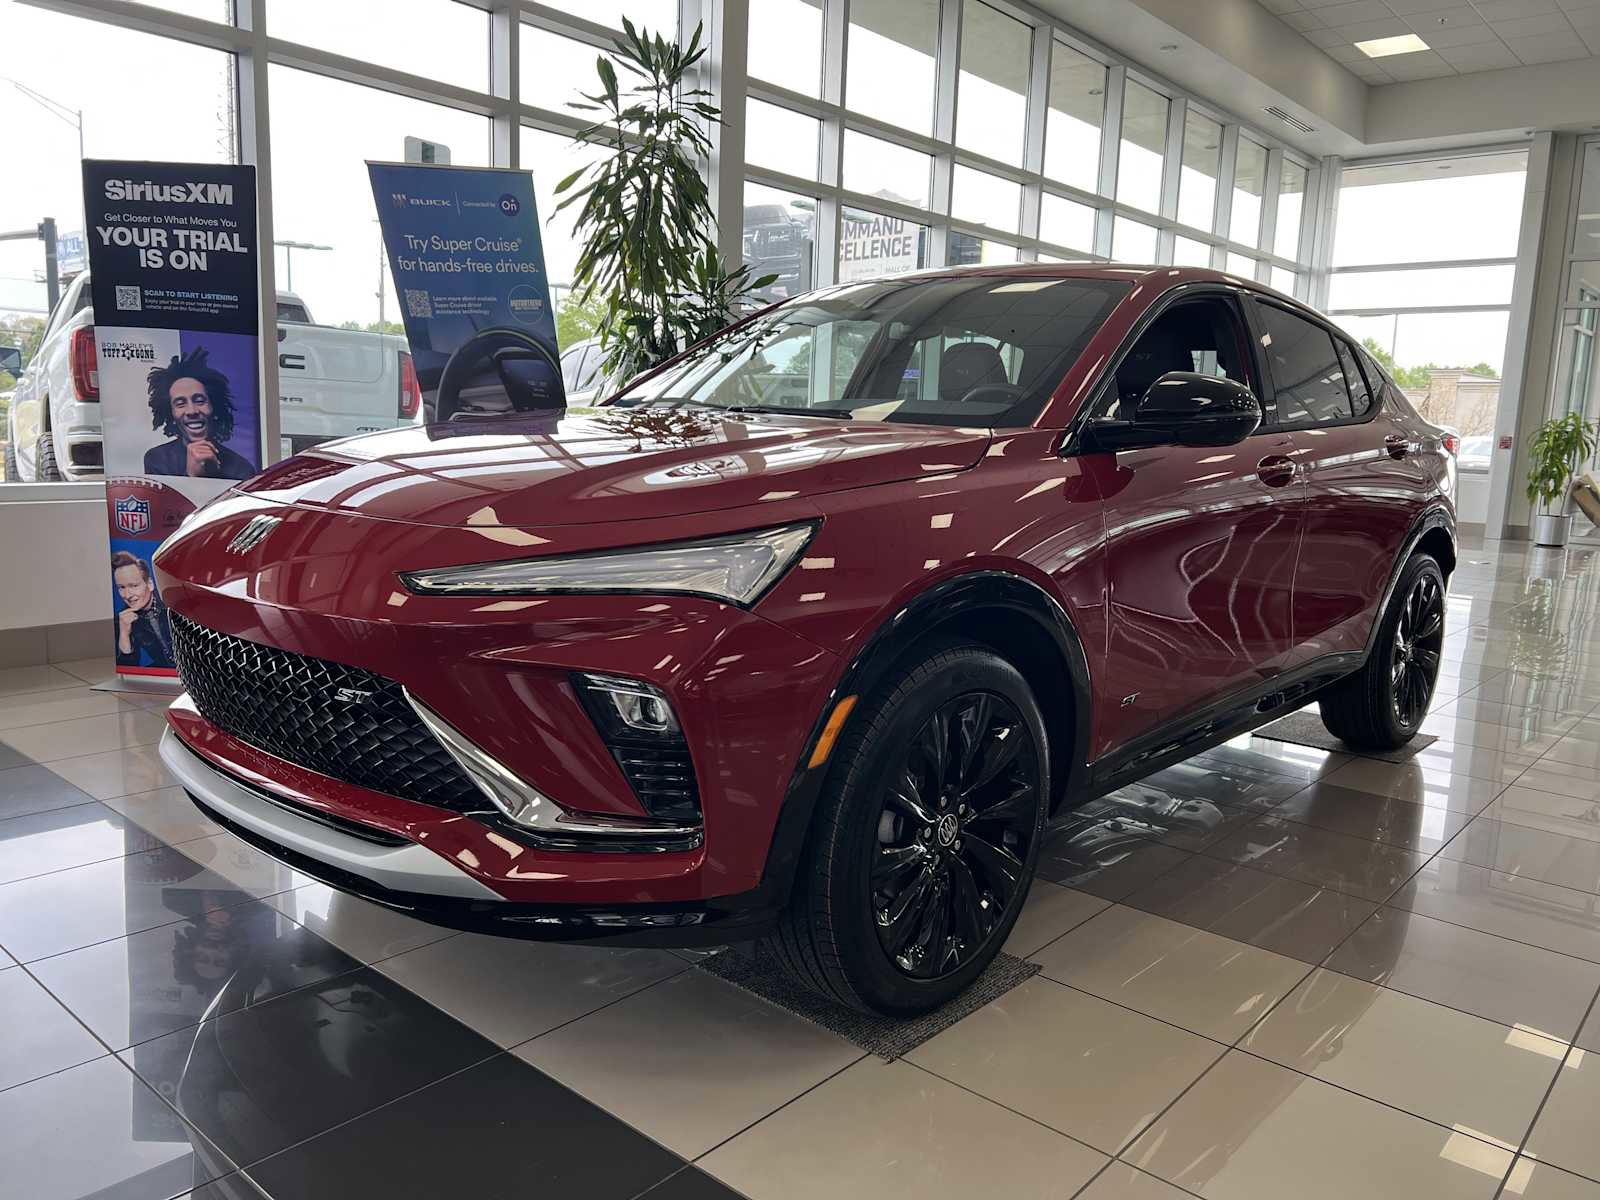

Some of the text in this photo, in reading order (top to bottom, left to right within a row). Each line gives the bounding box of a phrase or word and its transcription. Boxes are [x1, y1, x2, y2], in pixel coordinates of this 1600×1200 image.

[104, 179, 233, 205] SiriusXM
[104, 213, 237, 228] Get Closer to What Moves You
[96, 226, 248, 253] YOUR TRIAL
[404, 234, 428, 253] Try
[431, 236, 472, 253] Super
[138, 249, 208, 271] IS ON
[398, 256, 539, 273] for hands-free drives.
[144, 289, 164, 297] SCAN
[177, 291, 200, 299] START
[201, 292, 239, 302] LISTENING
[120, 512, 148, 528] NFL
